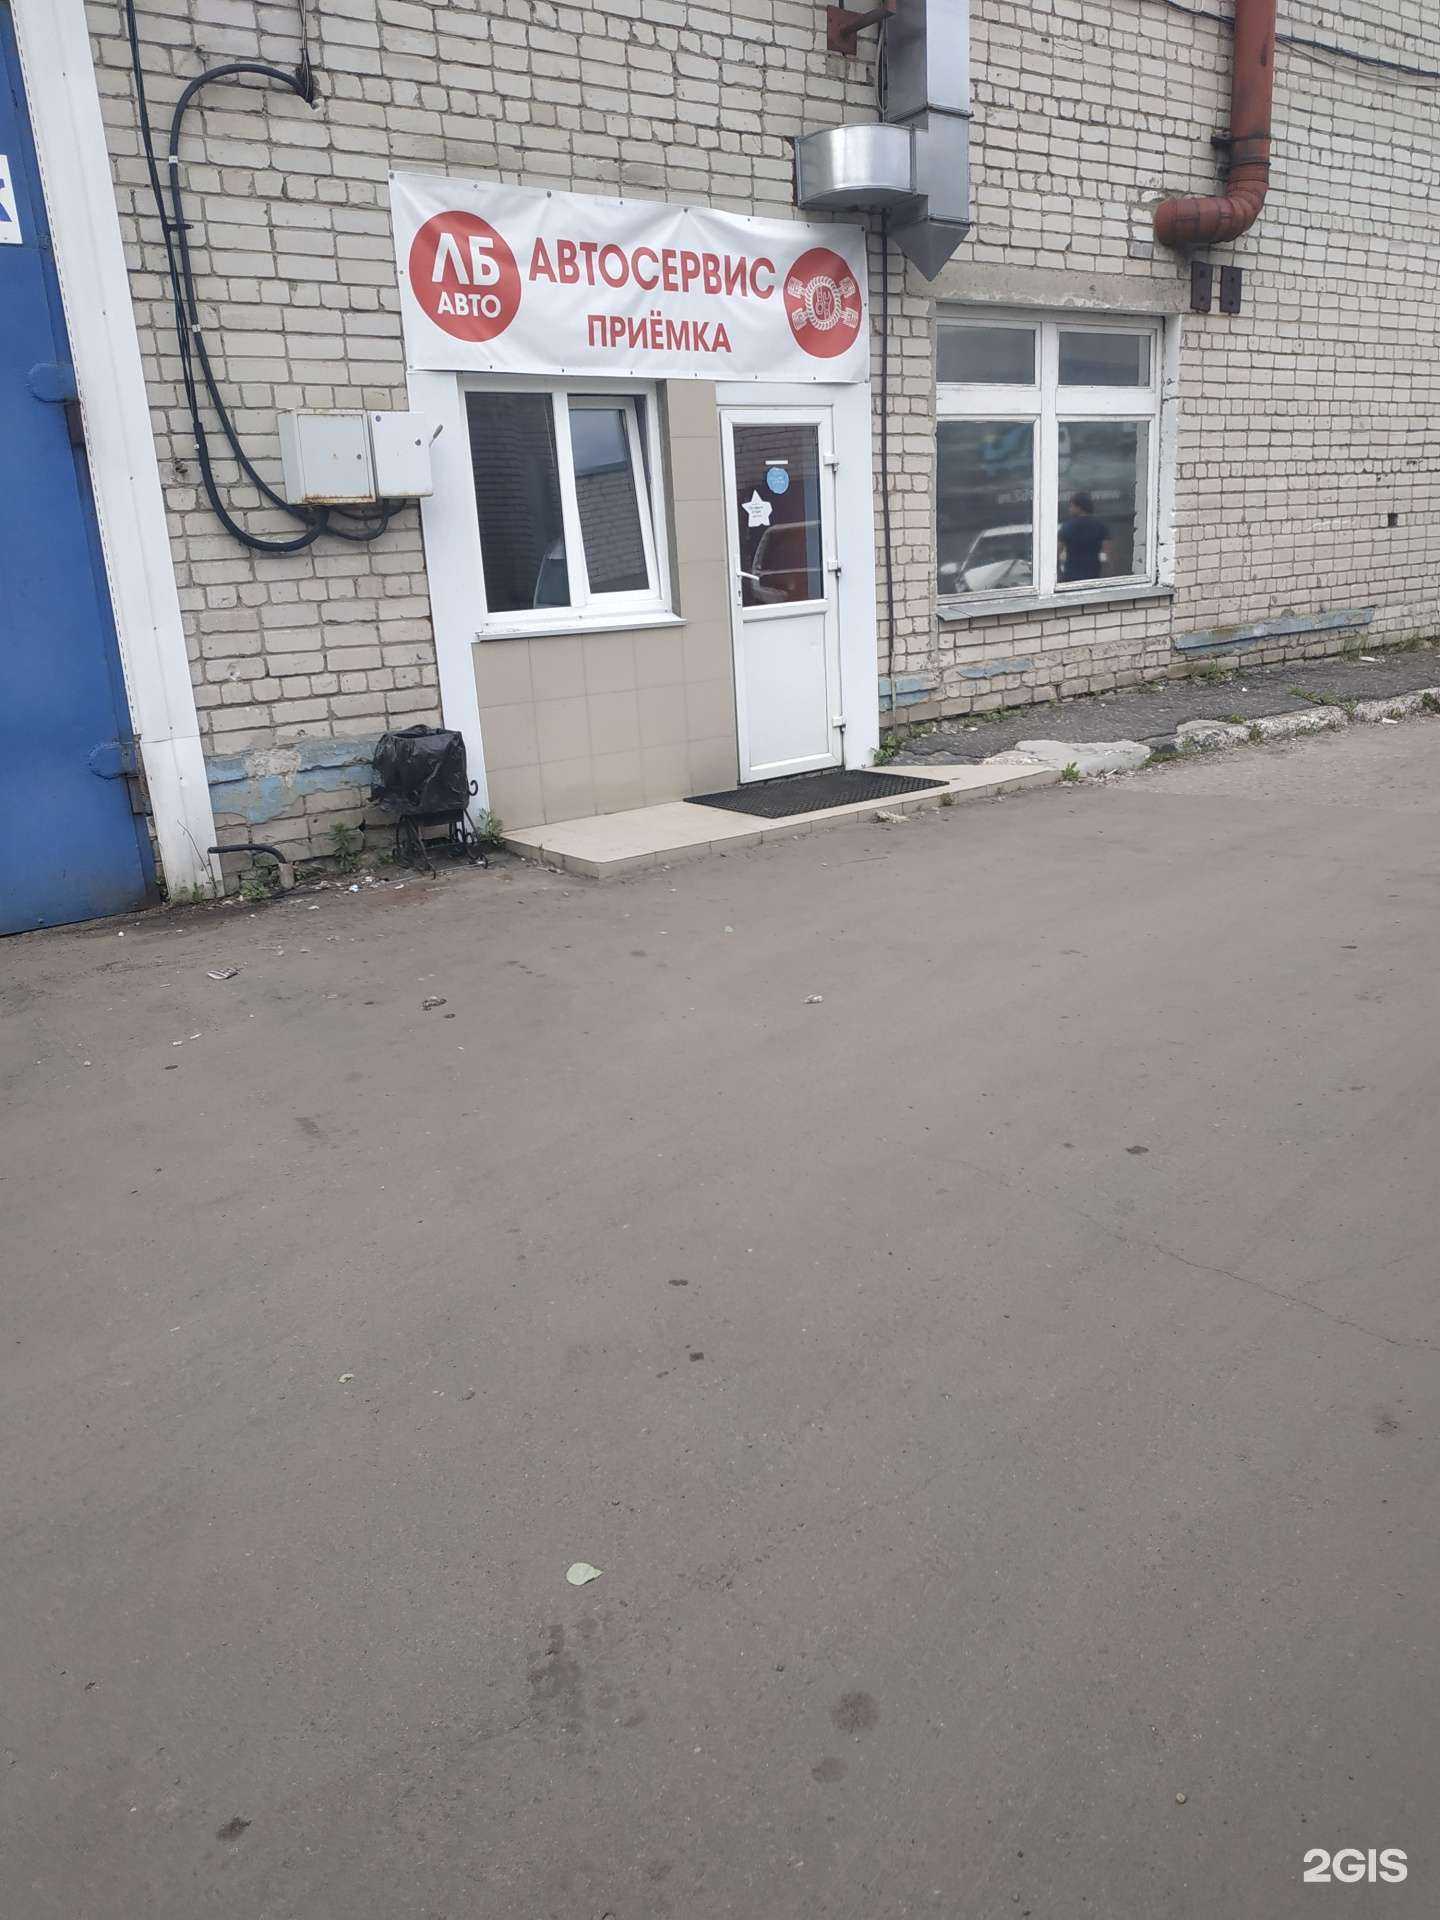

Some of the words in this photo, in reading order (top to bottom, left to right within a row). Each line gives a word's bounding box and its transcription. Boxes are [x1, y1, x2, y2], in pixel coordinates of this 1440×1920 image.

[431, 232, 501, 287] ЛБ
[528, 237, 776, 300] АВТОСЕРВИС
[436, 293, 502, 319] АВТО
[587, 310, 733, 353] ПРИЁМКА
